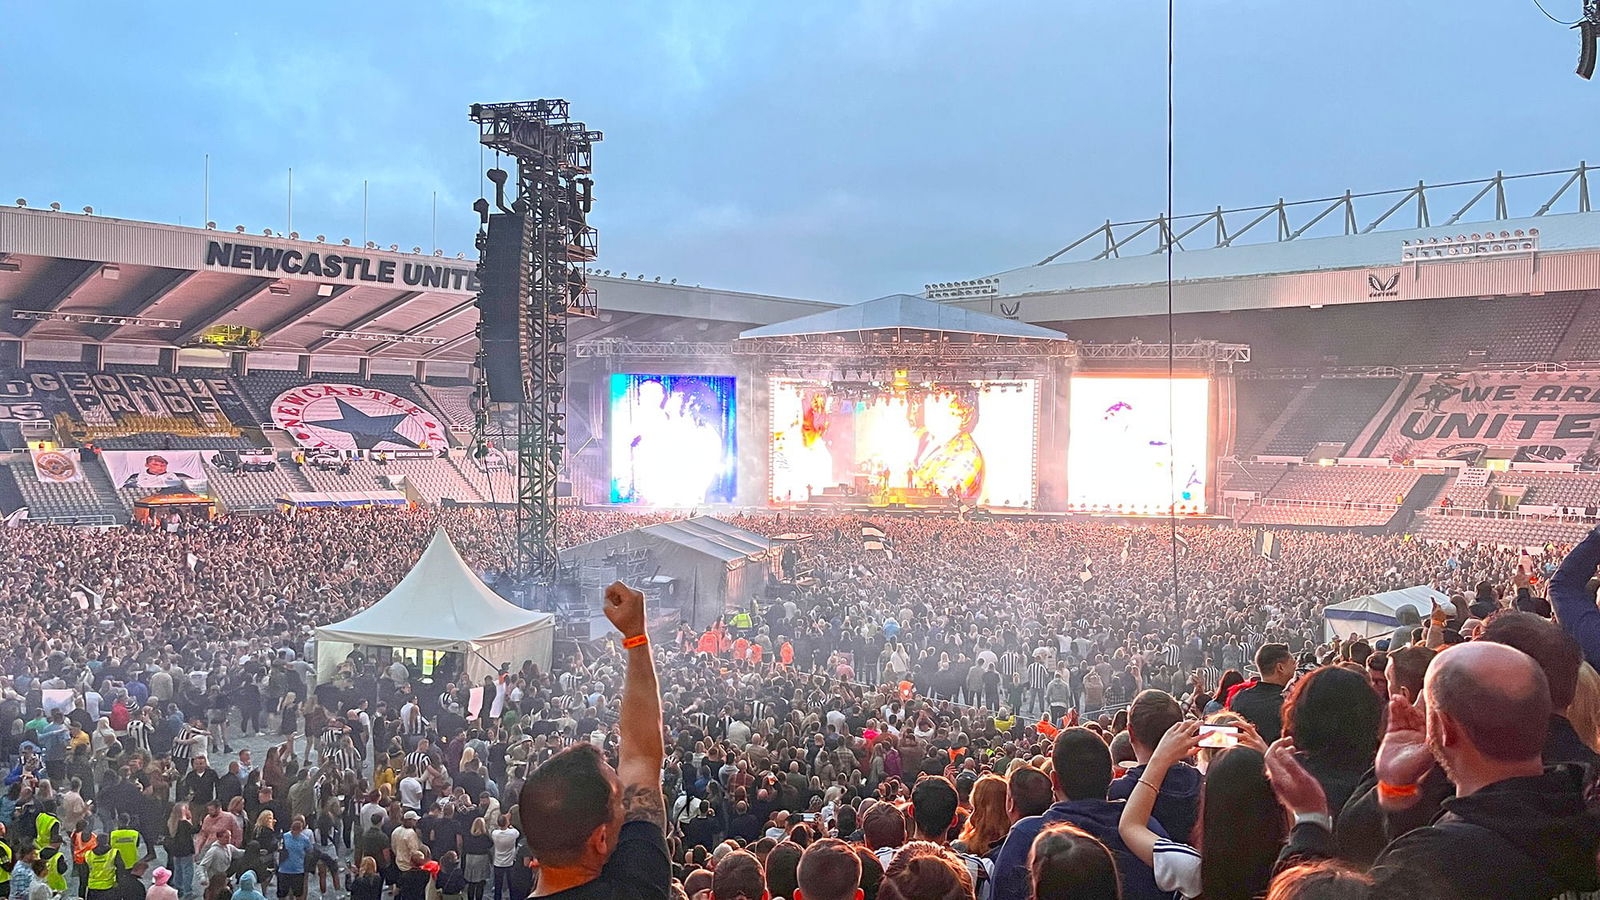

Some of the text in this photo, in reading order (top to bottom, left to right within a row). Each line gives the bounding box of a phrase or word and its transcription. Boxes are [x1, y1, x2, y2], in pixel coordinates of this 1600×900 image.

[206, 241, 397, 283] NEWCASTLE
[30, 373, 235, 397] GEORDIE
[1460, 385, 1522, 402] WE
[74, 393, 221, 417] PRIDE
[278, 385, 425, 428] NEWCASTLE
[1400, 412, 1600, 441] UNITE
